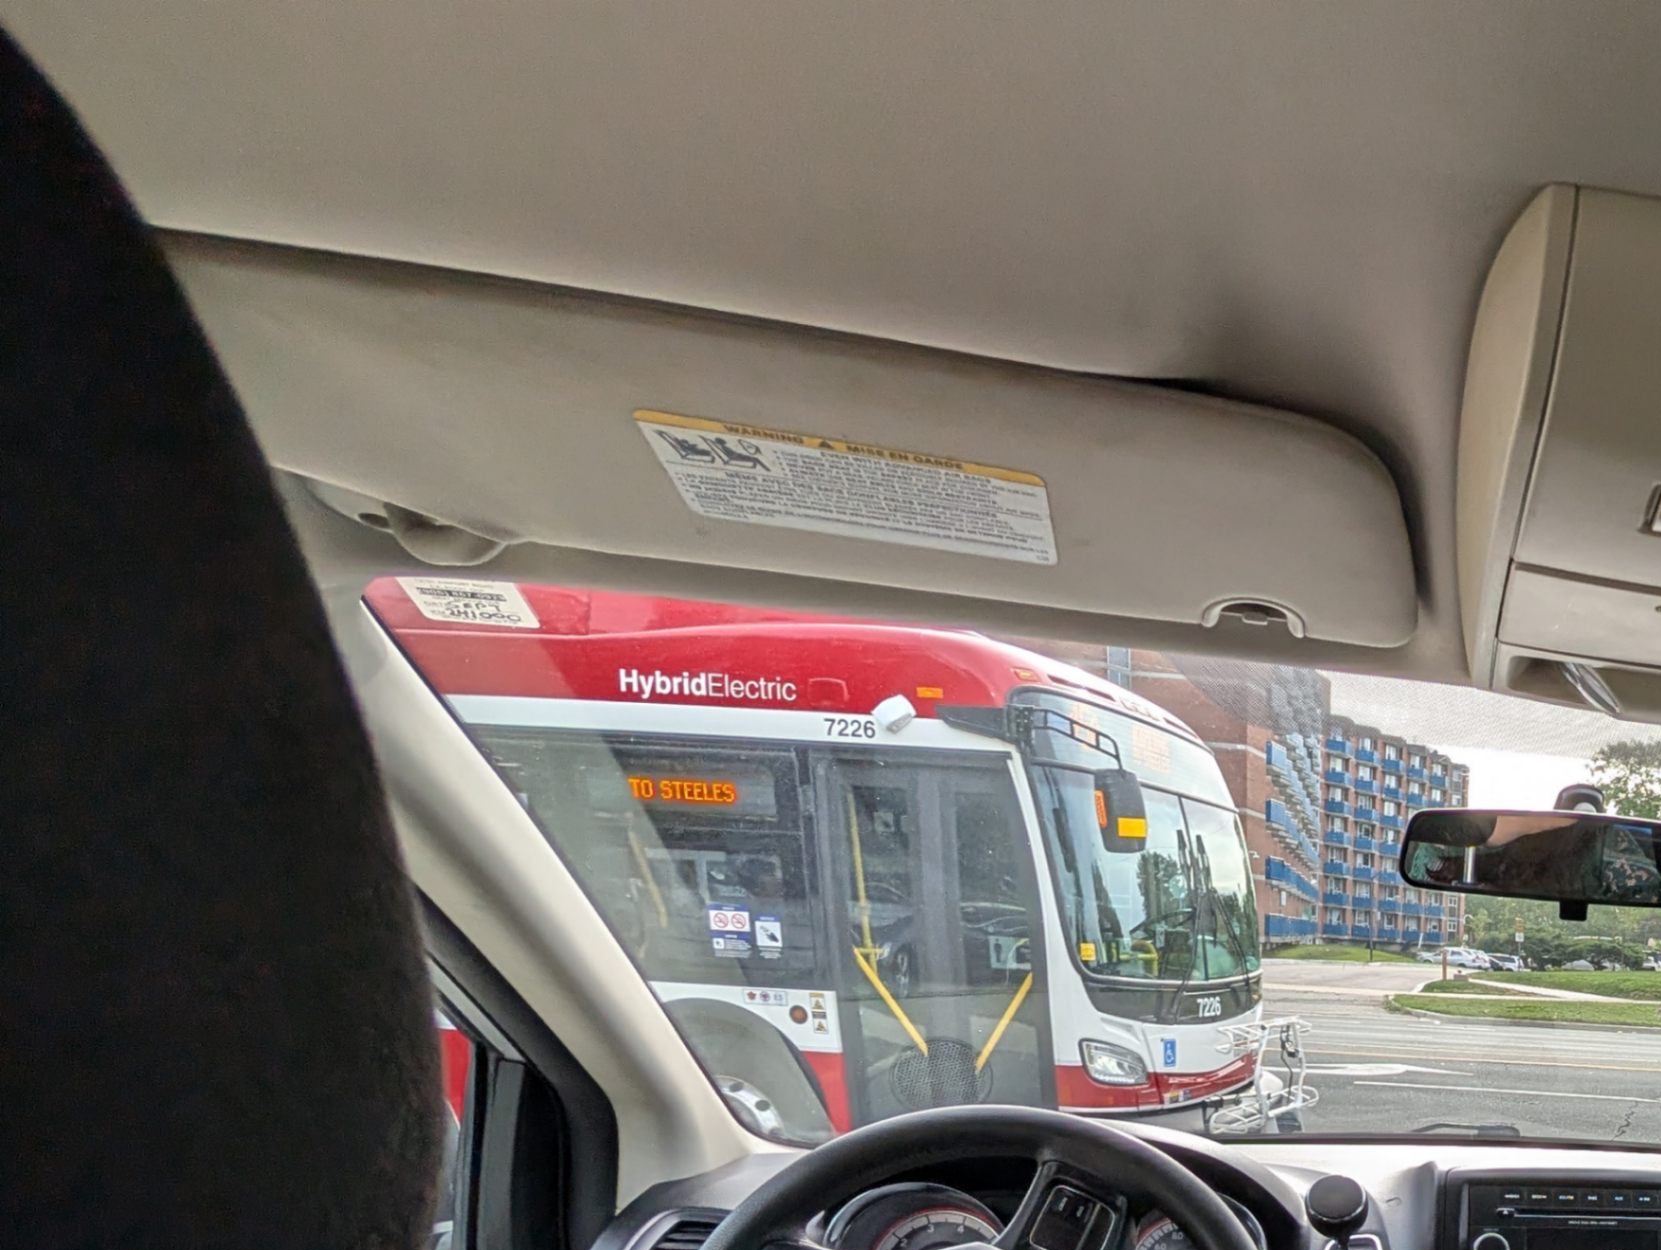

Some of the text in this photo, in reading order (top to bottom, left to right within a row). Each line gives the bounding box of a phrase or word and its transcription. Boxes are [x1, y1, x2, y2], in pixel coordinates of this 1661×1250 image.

[723, 424, 964, 470] WARNING MISE EN GARDE
[619, 668, 797, 701] HybridElectric
[823, 718, 876, 739] 7226
[628, 776, 736, 803] TO STEELES
[1196, 996, 1222, 1018] 7226
[926, 1223, 935, 1233] 3
[956, 1223, 965, 1233] 4
